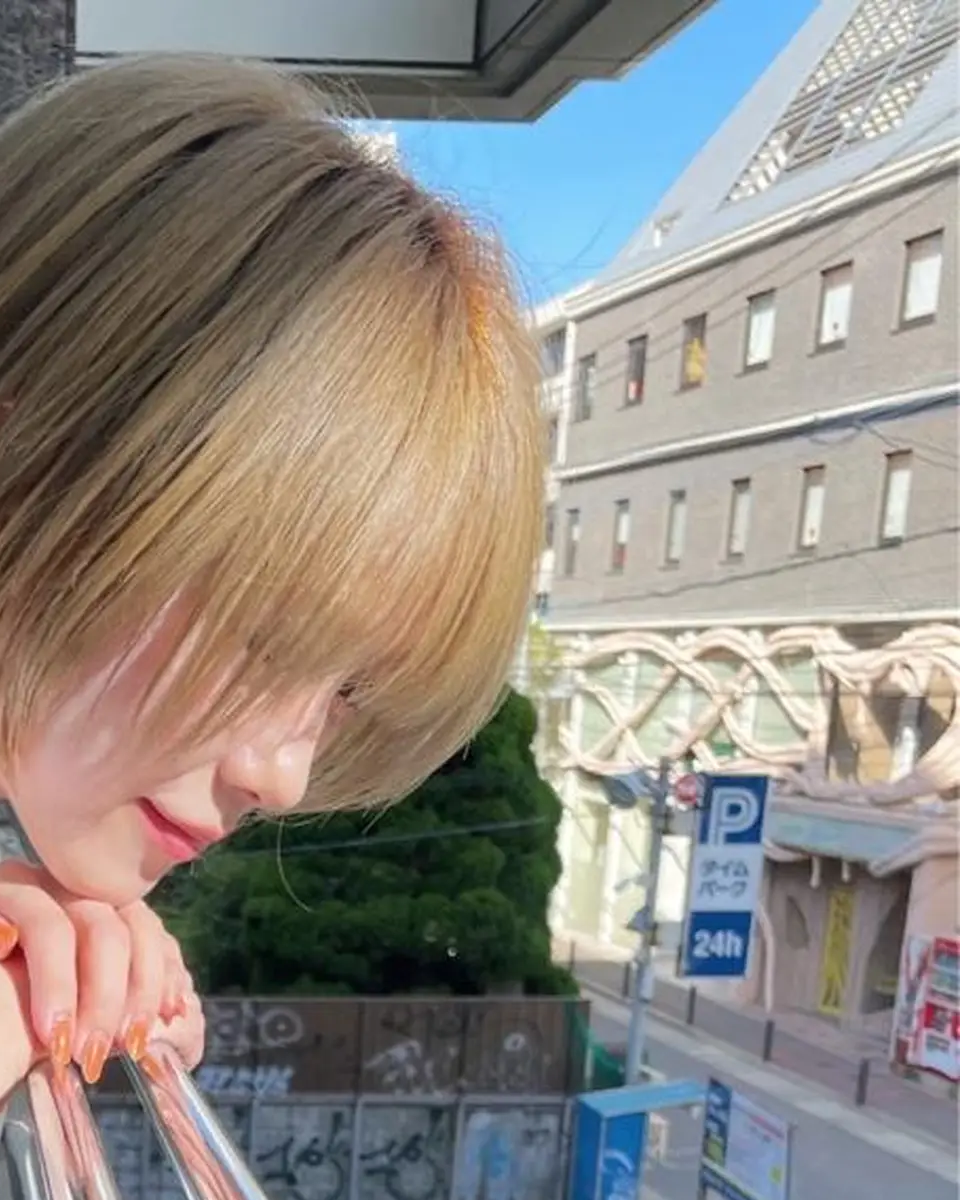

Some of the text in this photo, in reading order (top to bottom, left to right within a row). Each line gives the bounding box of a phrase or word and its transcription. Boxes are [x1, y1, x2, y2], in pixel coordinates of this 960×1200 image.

[708, 786, 759, 846] P
[701, 859, 748, 878] タイム
[693, 929, 743, 958] 24h
